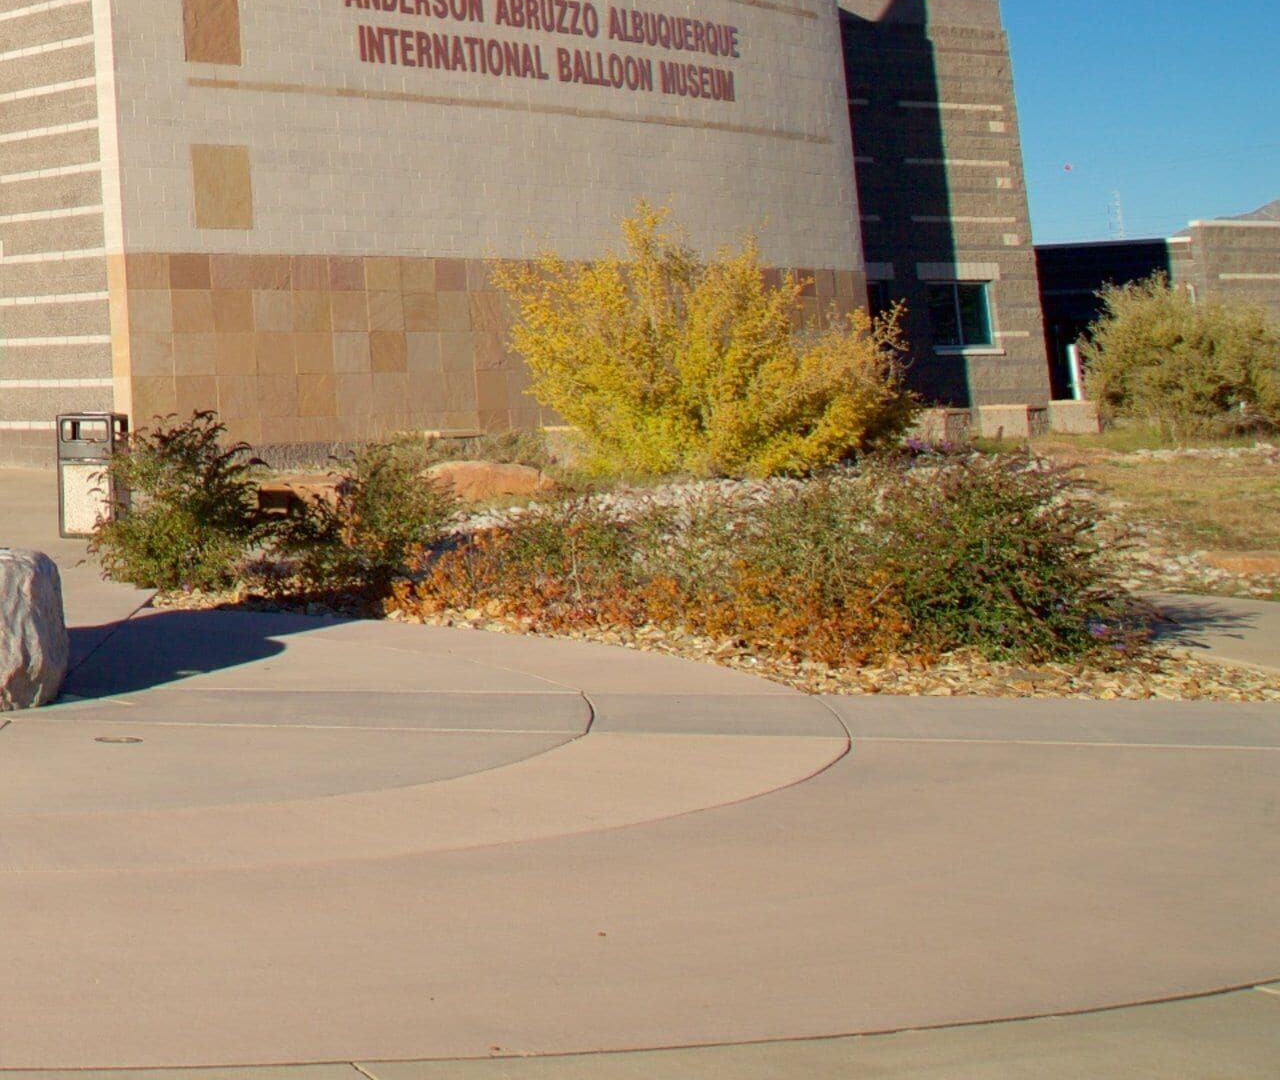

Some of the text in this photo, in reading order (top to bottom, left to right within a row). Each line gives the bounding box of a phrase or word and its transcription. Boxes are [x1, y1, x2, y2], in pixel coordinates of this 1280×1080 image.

[358, 24, 736, 102] INTERNATIONAL BALLOON MUSEUM
[608, 7, 741, 58] ALBUQUERQUE
